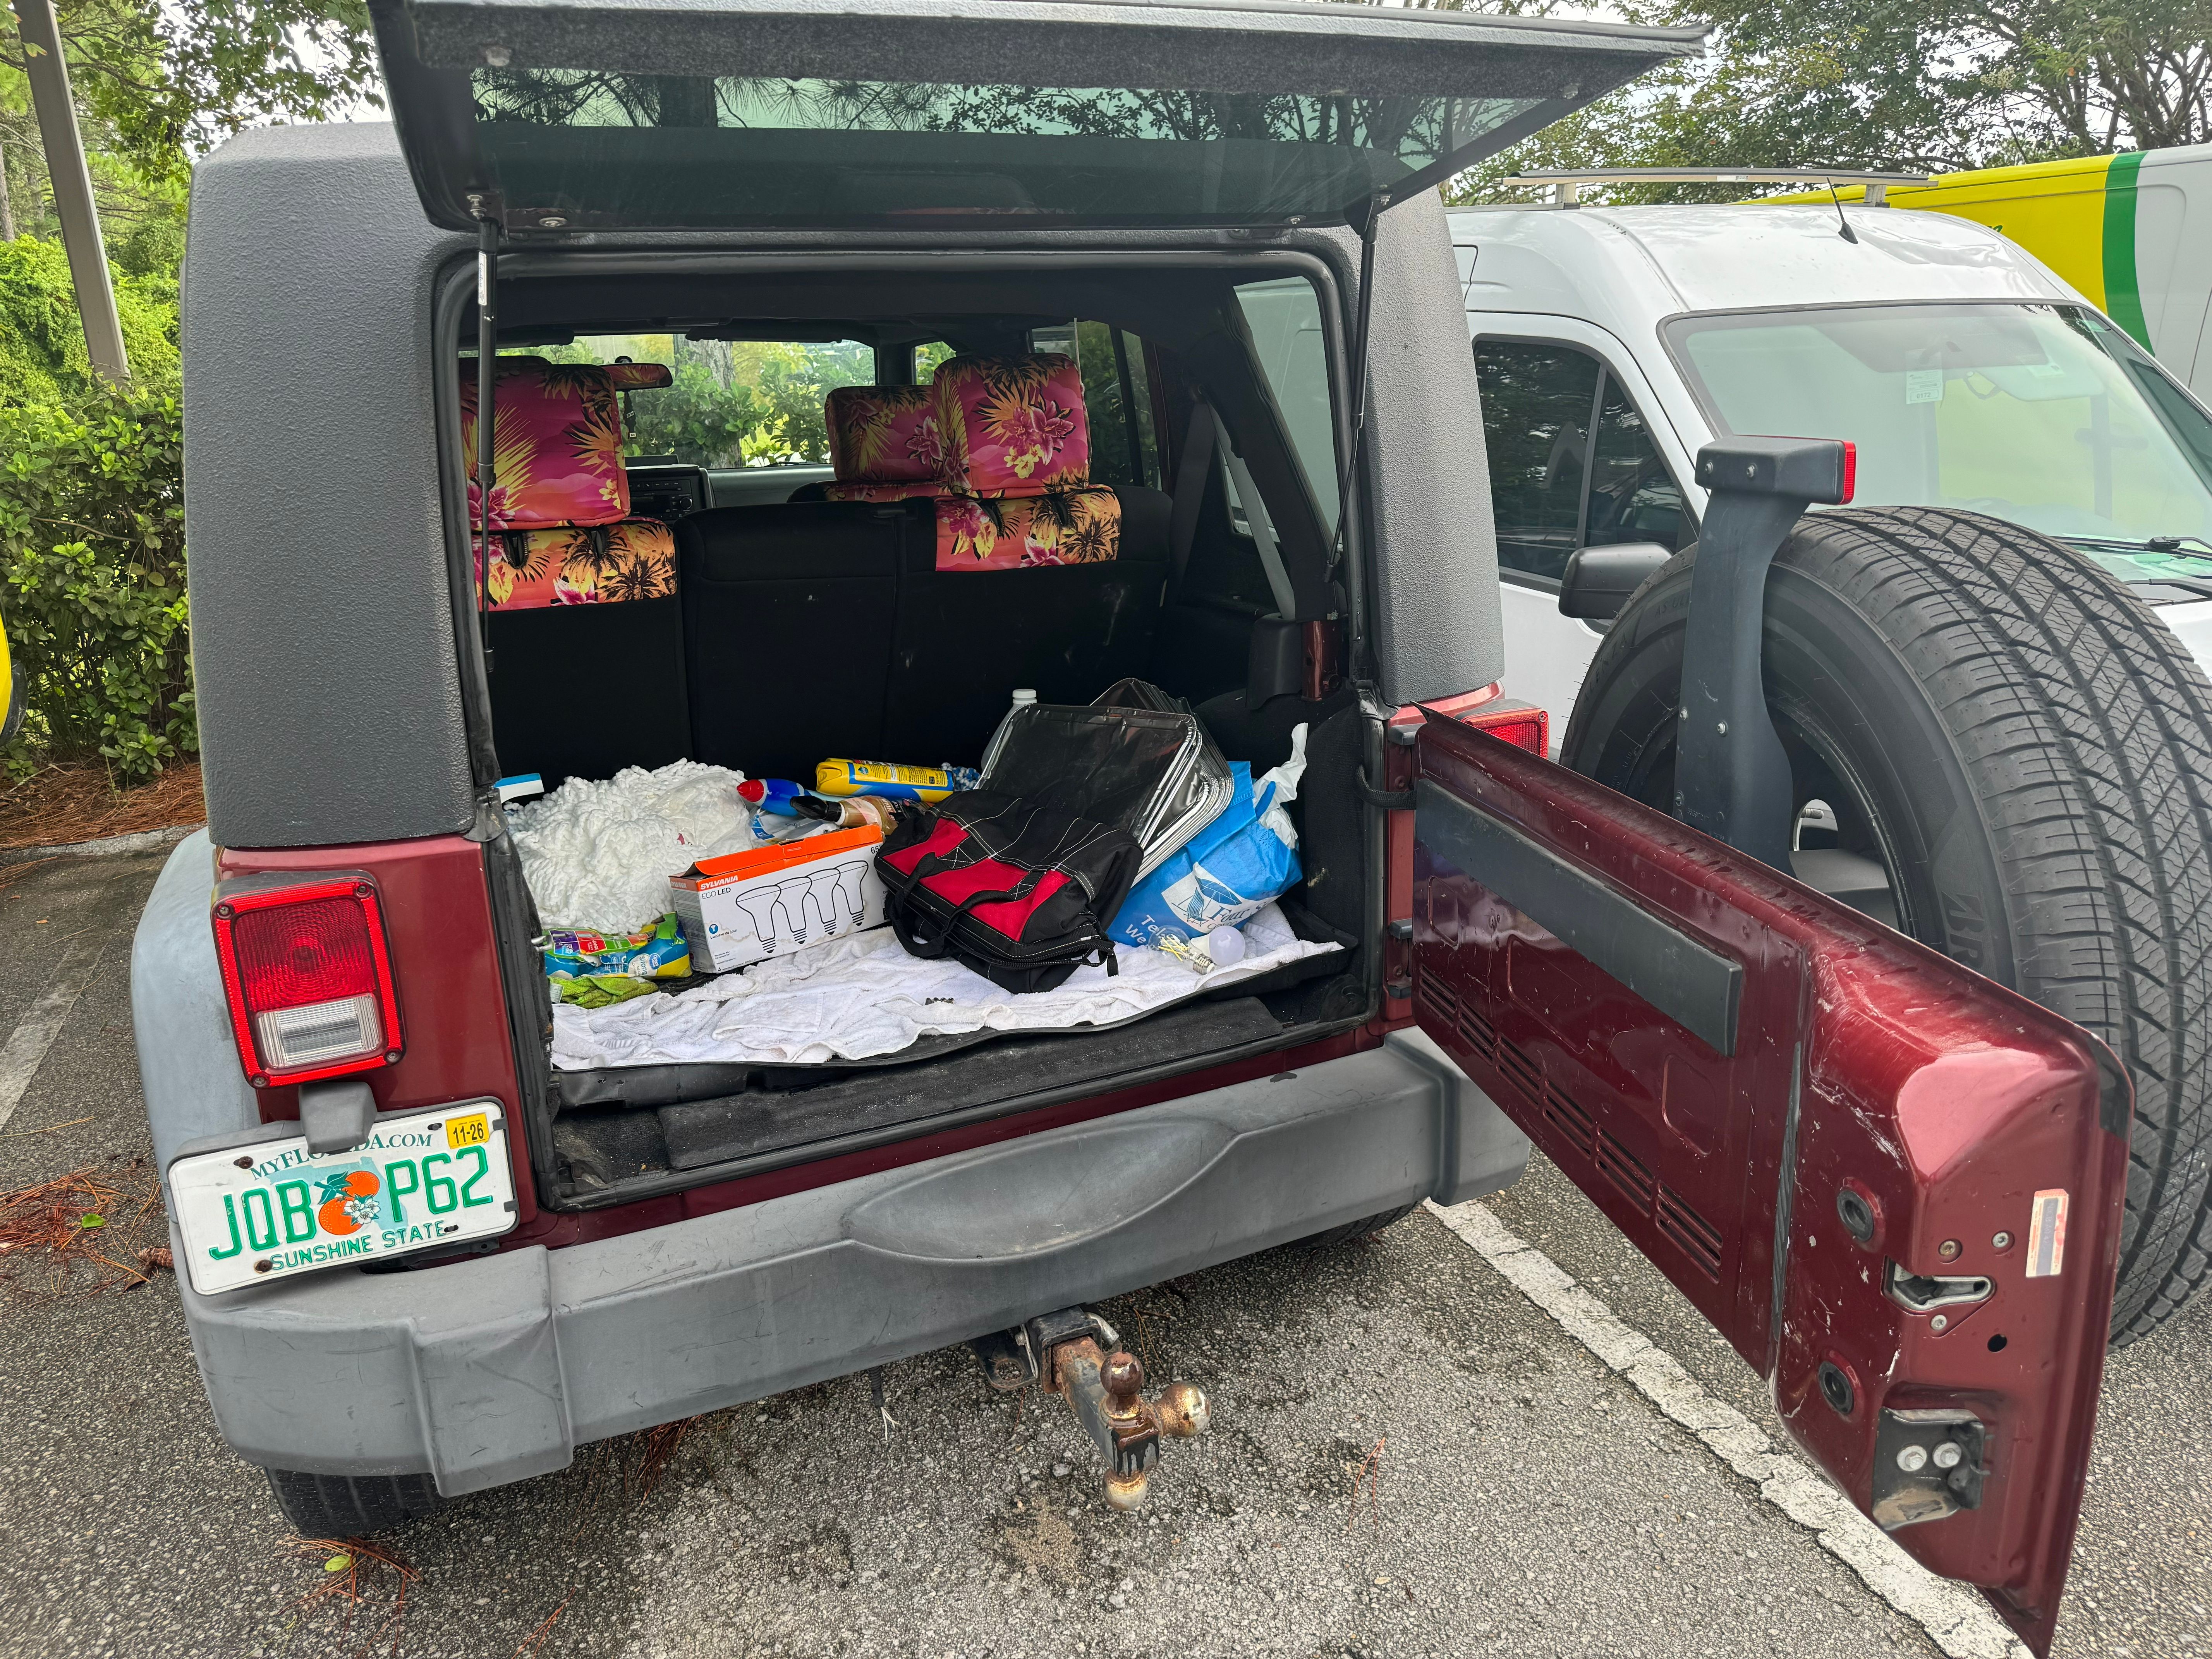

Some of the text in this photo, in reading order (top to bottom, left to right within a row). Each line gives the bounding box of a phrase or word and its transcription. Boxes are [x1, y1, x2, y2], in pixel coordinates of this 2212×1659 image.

[701, 875, 738, 890] SYLVANIA
[702, 887, 731, 900] ECO LED
[453, 1122, 484, 1144] 11-26
[250, 1133, 433, 1180] MYFLODA.COM
[209, 1145, 493, 1261] JQB P62
[271, 1220, 446, 1270] SUNSHINE STATE
